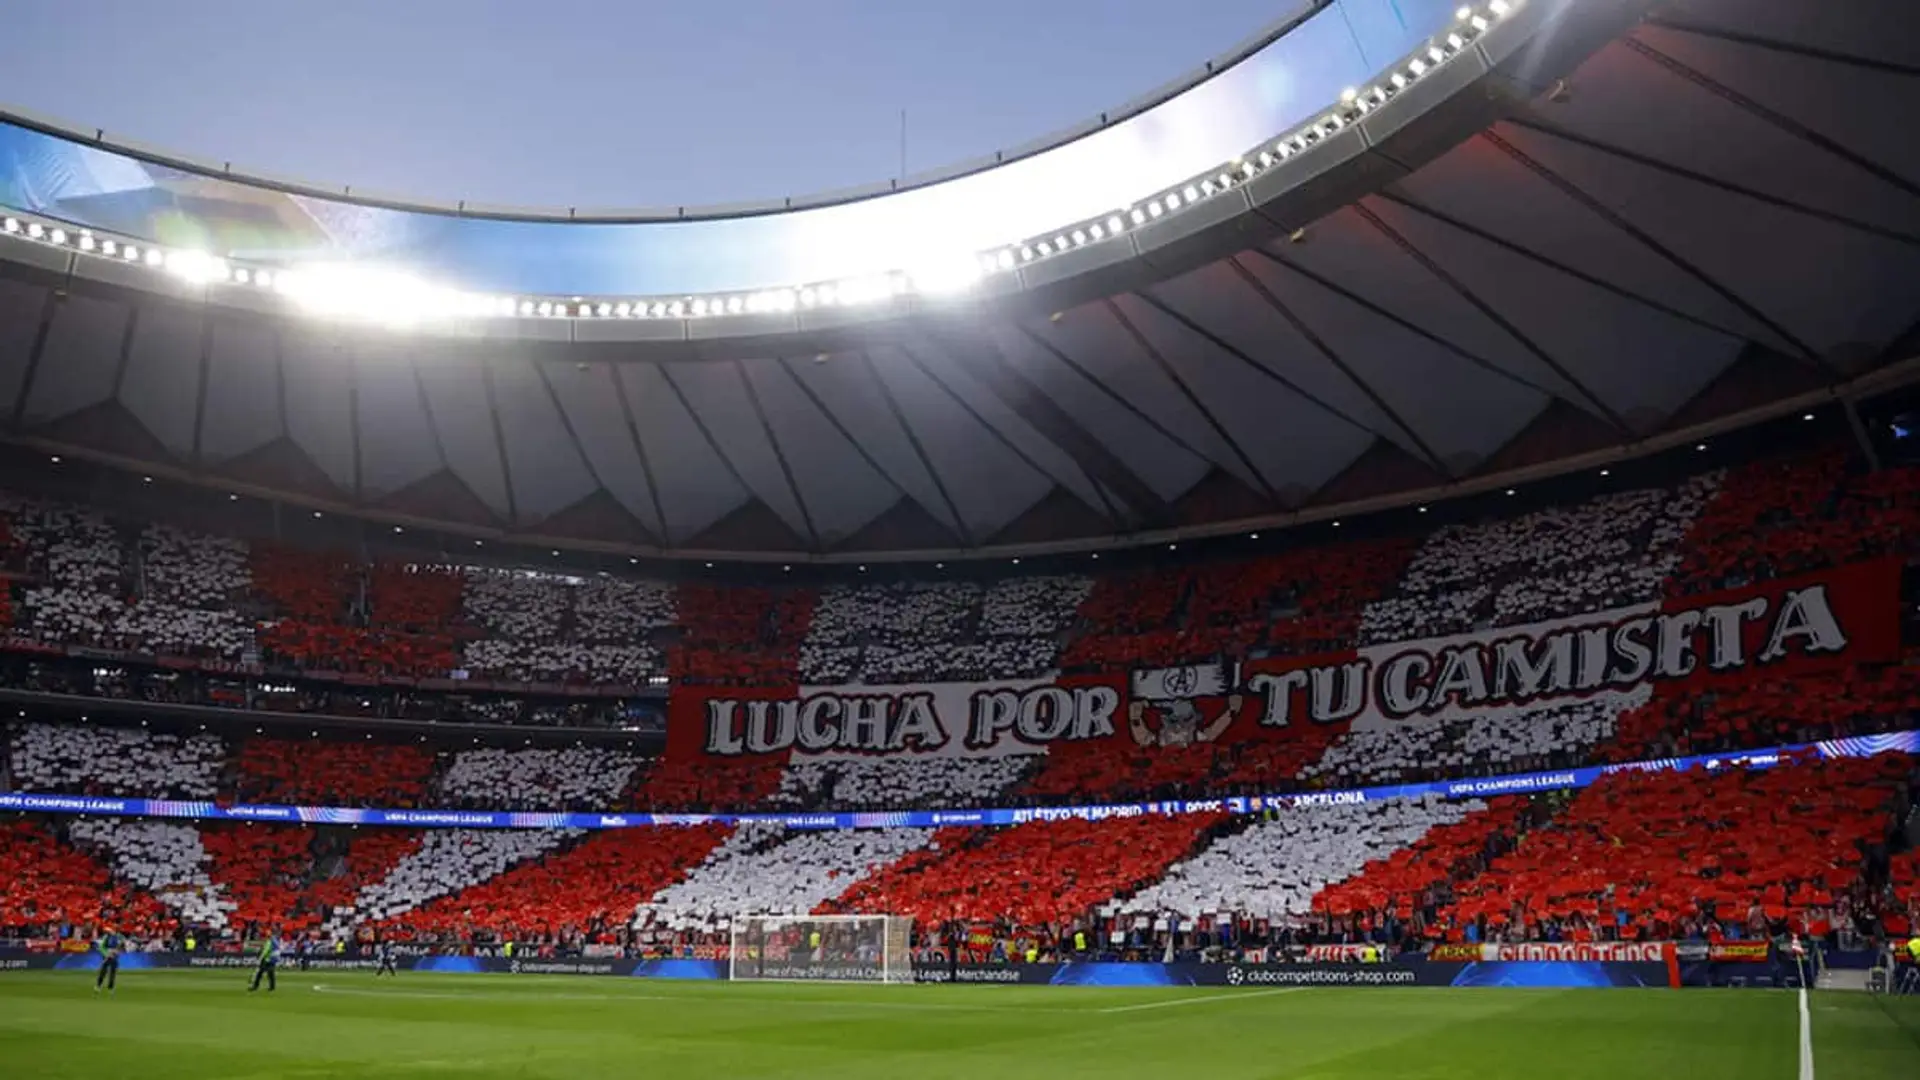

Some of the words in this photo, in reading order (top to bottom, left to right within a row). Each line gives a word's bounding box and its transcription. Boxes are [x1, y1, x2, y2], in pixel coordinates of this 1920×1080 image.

[706, 692, 948, 756] LUCHA
[971, 685, 1119, 746] POR
[1248, 656, 1371, 728] TU
[1377, 584, 1849, 718] CAMISETA
[955, 969, 1020, 981] Merchandise
[1247, 968, 1415, 983] clubcompetitions-shop.com
